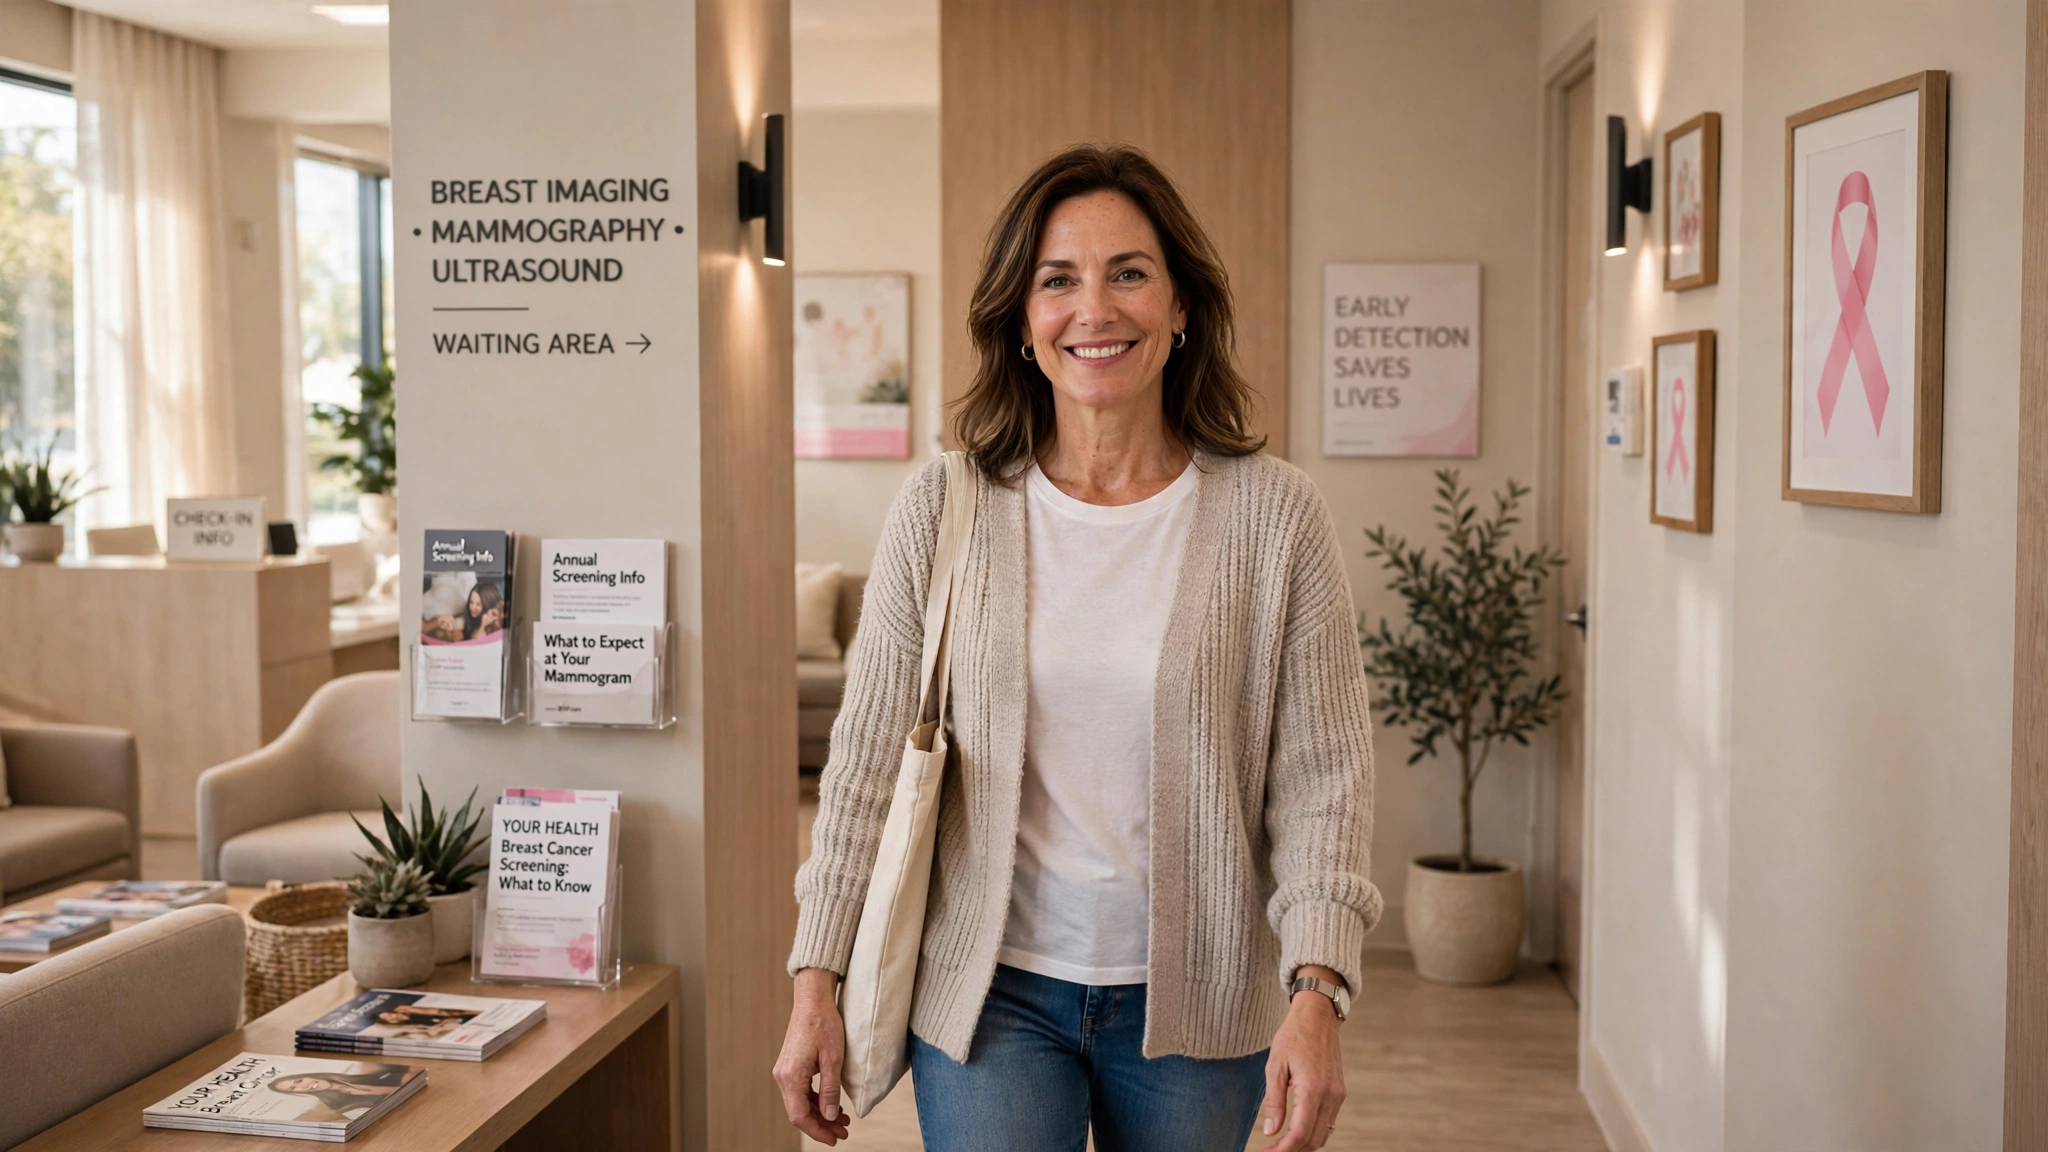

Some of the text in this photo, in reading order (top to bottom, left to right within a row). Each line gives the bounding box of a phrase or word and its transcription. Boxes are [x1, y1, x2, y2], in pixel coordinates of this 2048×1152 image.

[431, 178, 669, 204] BREAST IMAGING
[432, 218, 665, 243] MAMMOGRAPHY
[433, 258, 623, 283] ULTRASOUND
[1334, 296, 1410, 318] EARLY
[433, 333, 615, 354] WAITING AREA
[1334, 326, 1470, 349] DETECTION
[1334, 356, 1411, 379] SAVES
[1334, 387, 1401, 408] LIVES
[173, 510, 253, 527] CHECK-IN
[194, 530, 234, 546] INFO
[553, 553, 597, 566] Annual
[553, 570, 645, 586] Screening Info
[545, 635, 644, 651] What to Expect
[545, 653, 590, 666] at Your
[545, 670, 632, 686] Mammogram
[502, 819, 599, 836] YOUR HEALTH
[502, 839, 593, 856] Breast Cancer
[500, 858, 569, 876] Screening:
[499, 876, 592, 893] What to Know
[168, 1087, 216, 1109] YOUR
